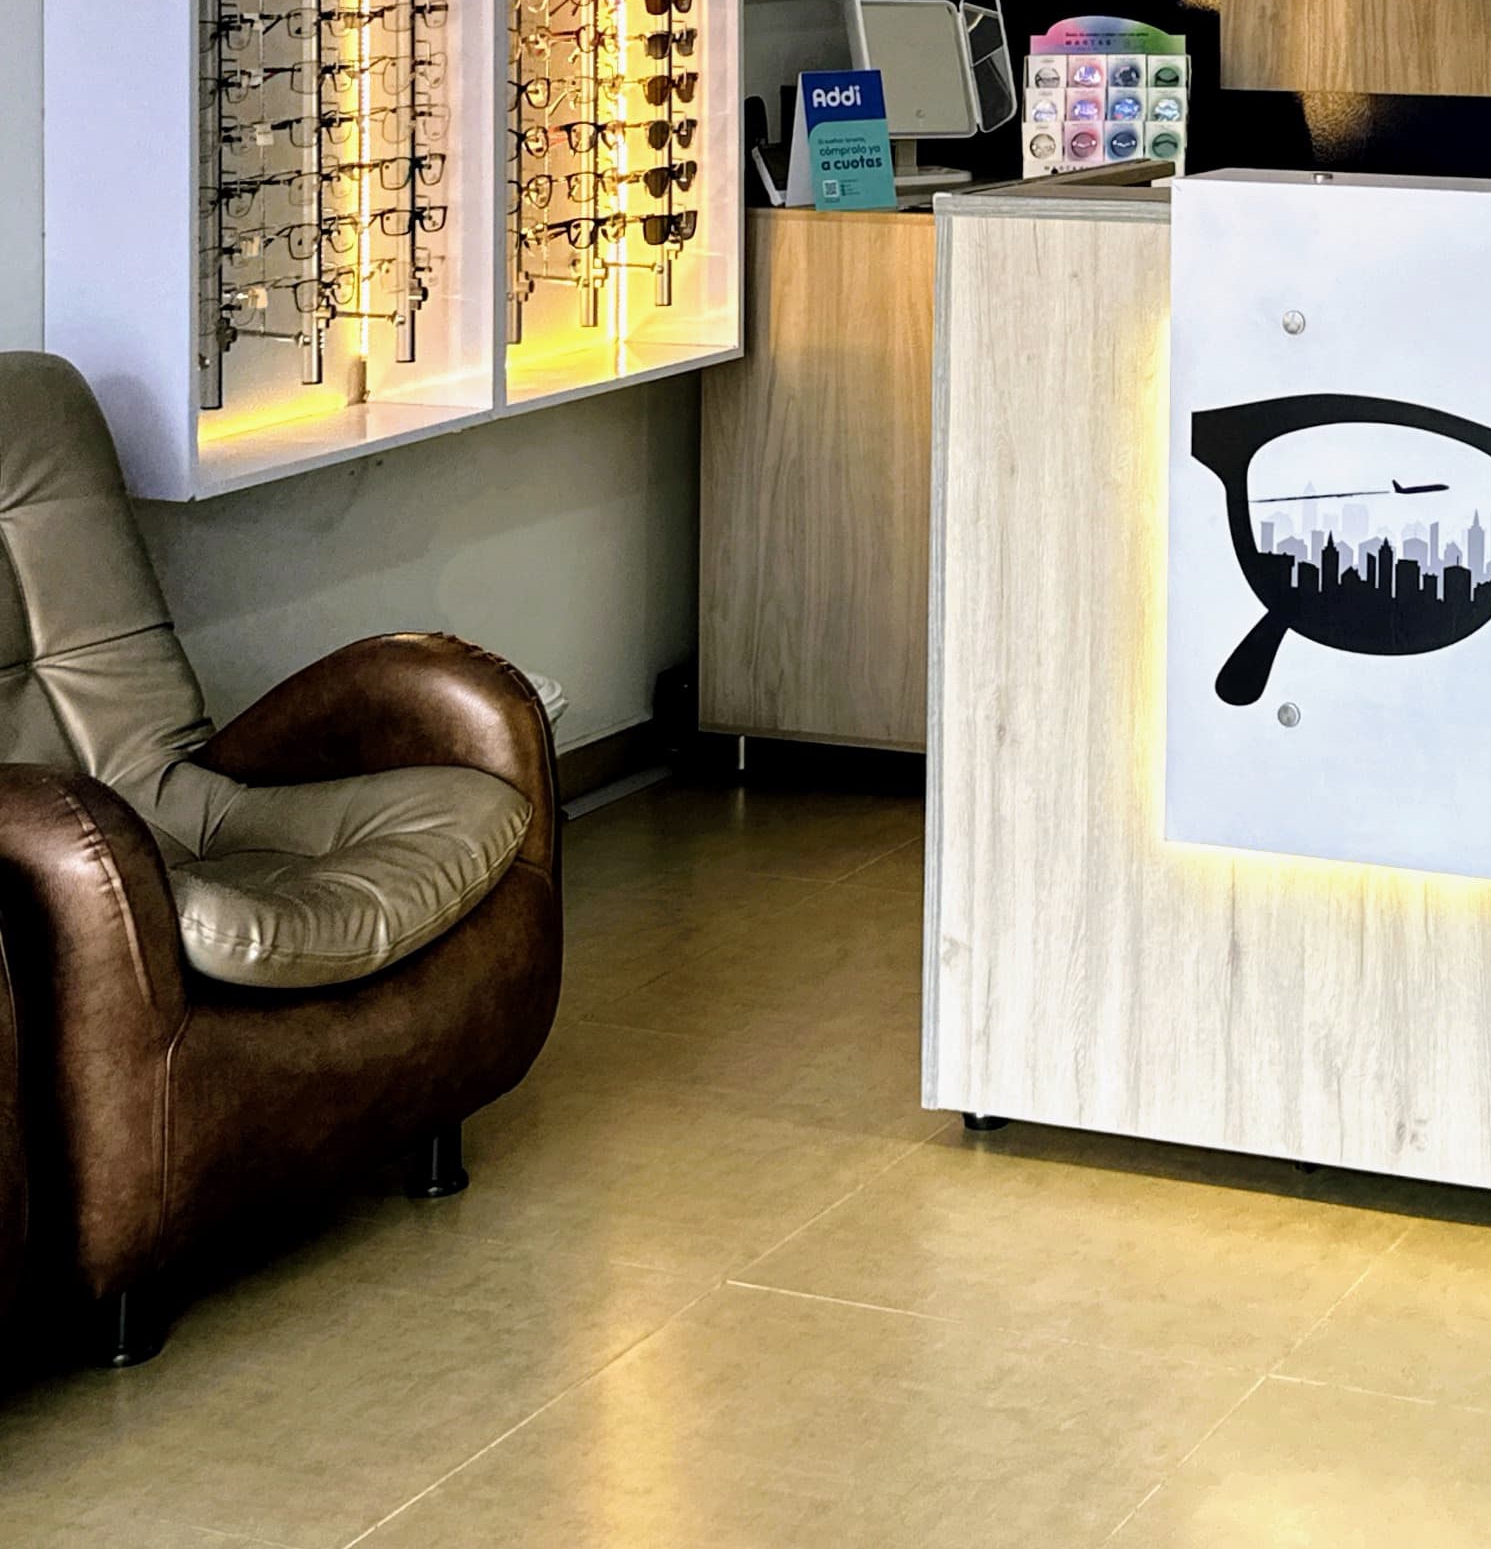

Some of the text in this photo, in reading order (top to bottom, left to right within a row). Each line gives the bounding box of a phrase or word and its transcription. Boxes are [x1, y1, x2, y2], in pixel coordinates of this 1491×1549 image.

[812, 85, 862, 108] Addi
[821, 156, 883, 171] a cuotas
